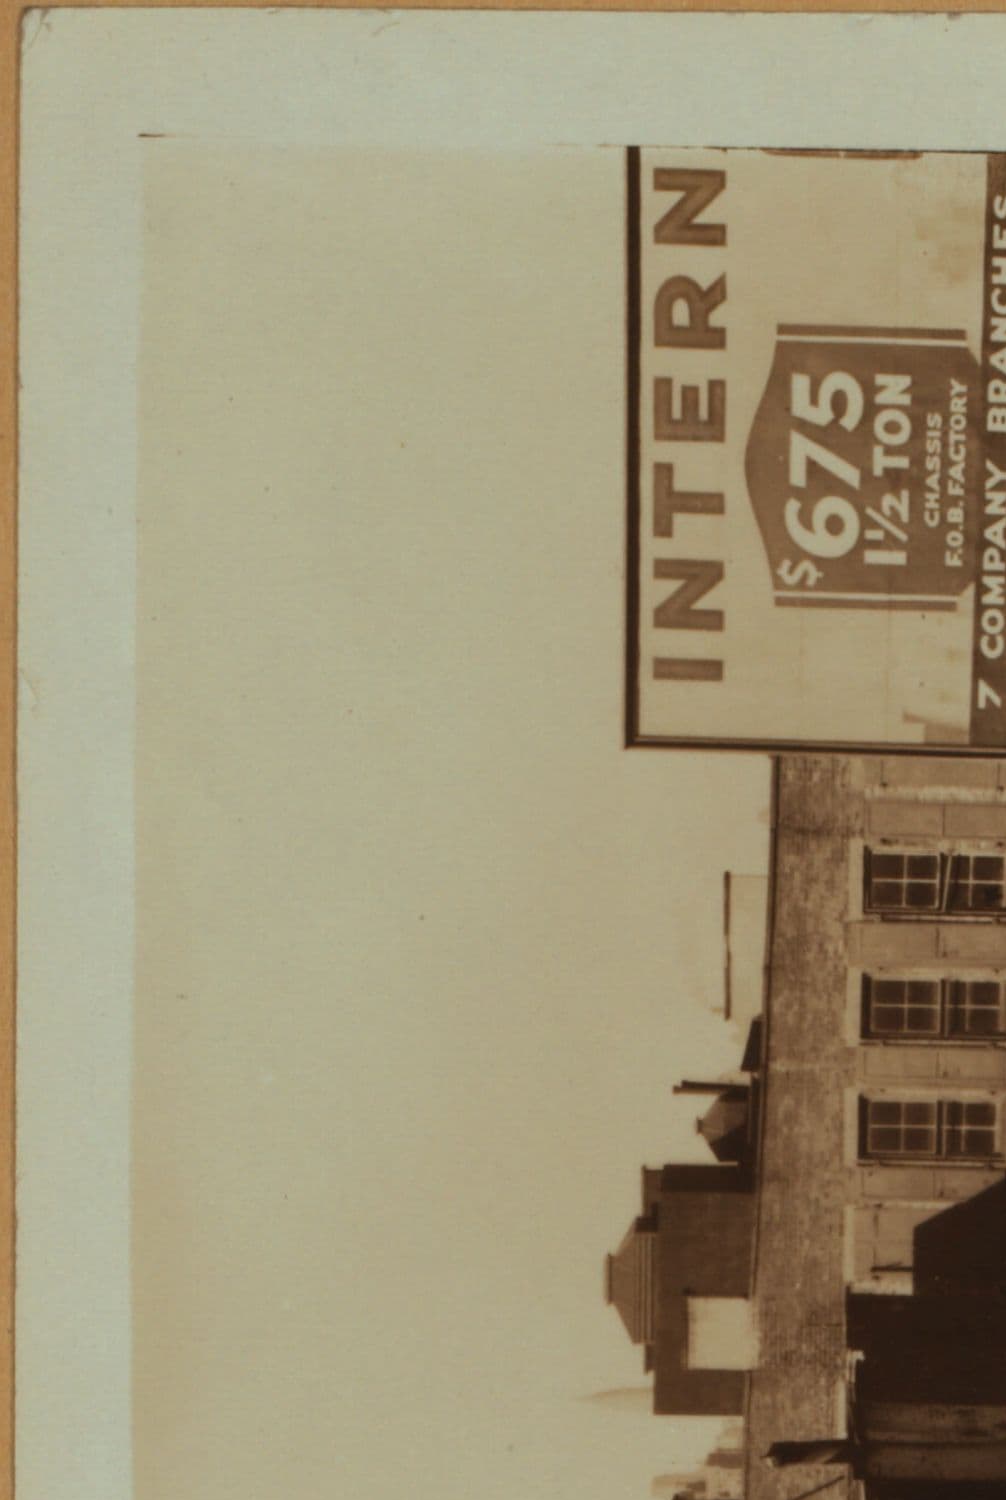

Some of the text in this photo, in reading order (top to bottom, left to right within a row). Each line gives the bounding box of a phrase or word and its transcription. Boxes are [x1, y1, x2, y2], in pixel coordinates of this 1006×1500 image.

[652, 165, 728, 683] INTERN
[775, 370, 864, 587] $675
[873, 373, 913, 475] TON
[923, 412, 944, 528] CHASSIS
[946, 378, 970, 567] F.O.B. FACTORY
[978, 680, 1003, 710] 7
